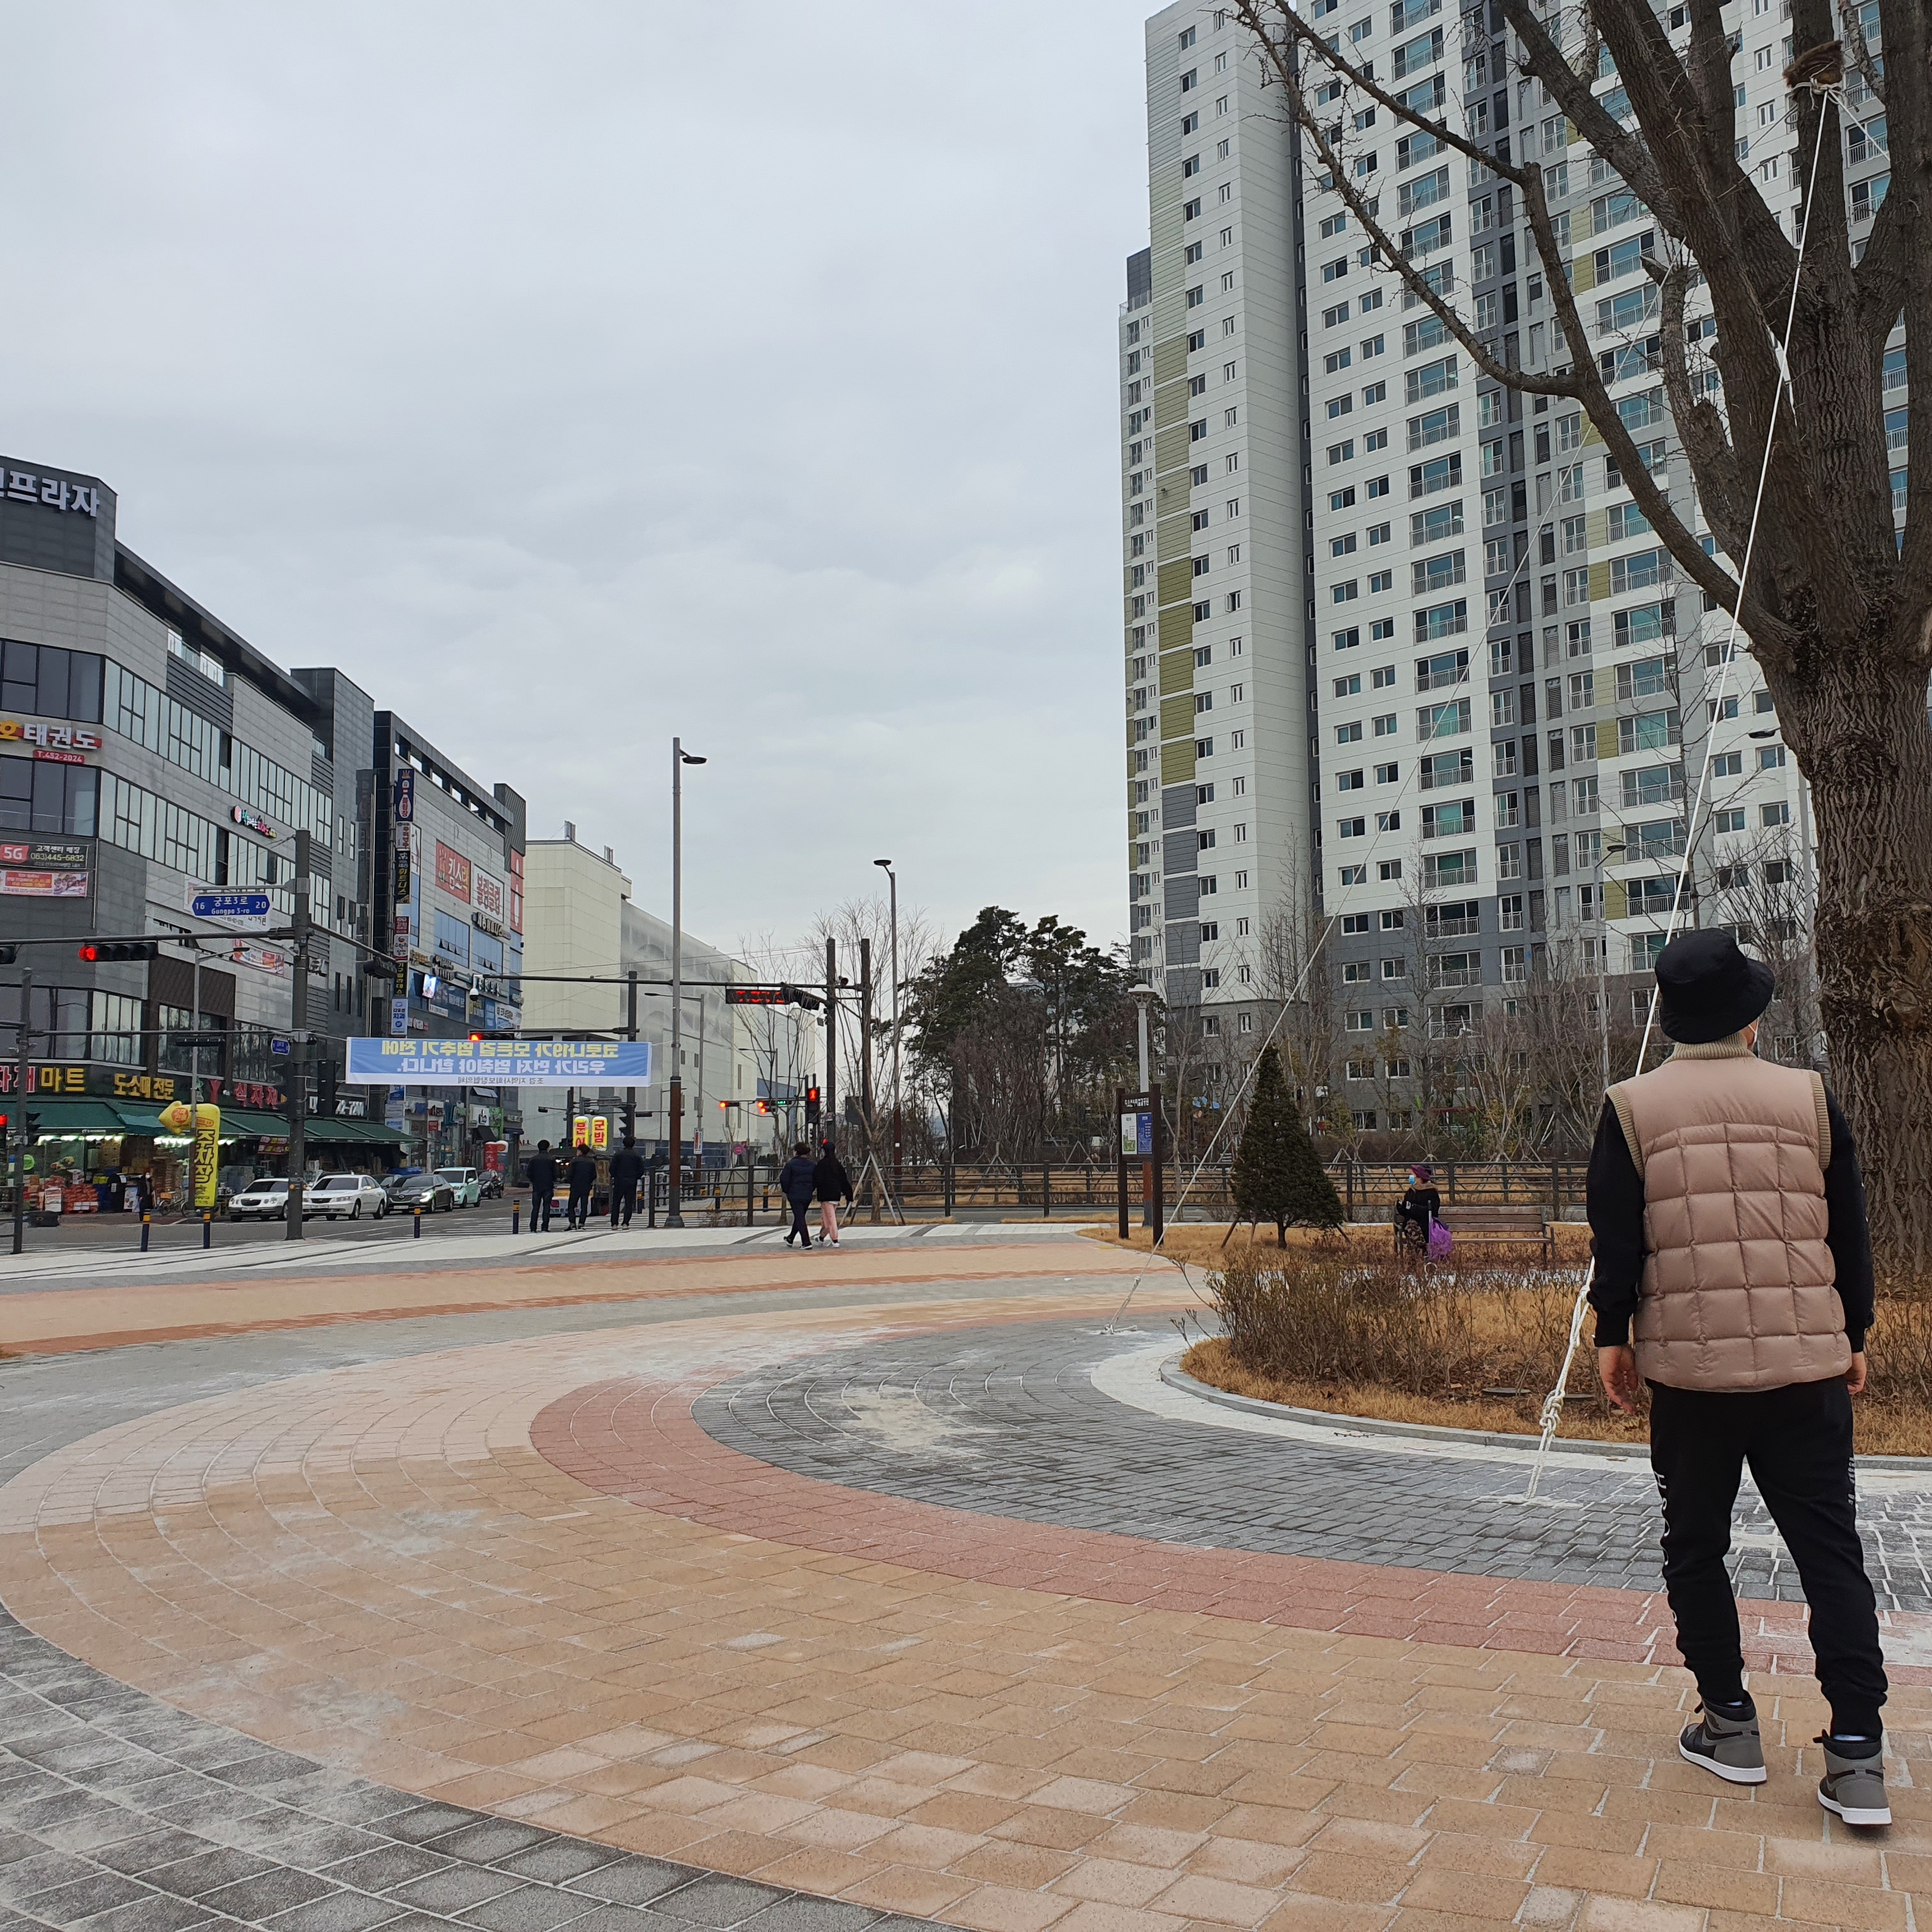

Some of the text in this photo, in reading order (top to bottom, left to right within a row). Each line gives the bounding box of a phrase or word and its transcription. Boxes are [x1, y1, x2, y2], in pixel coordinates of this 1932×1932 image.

[0, 466, 100, 518] 프라자
[37, 751, 82, 763] T.452-2024
[3, 847, 23, 860] 5G
[213, 896, 249, 907] 궁포3로
[234, 1082, 287, 1110] 식자재
[594, 1120, 604, 1143] 군밤
